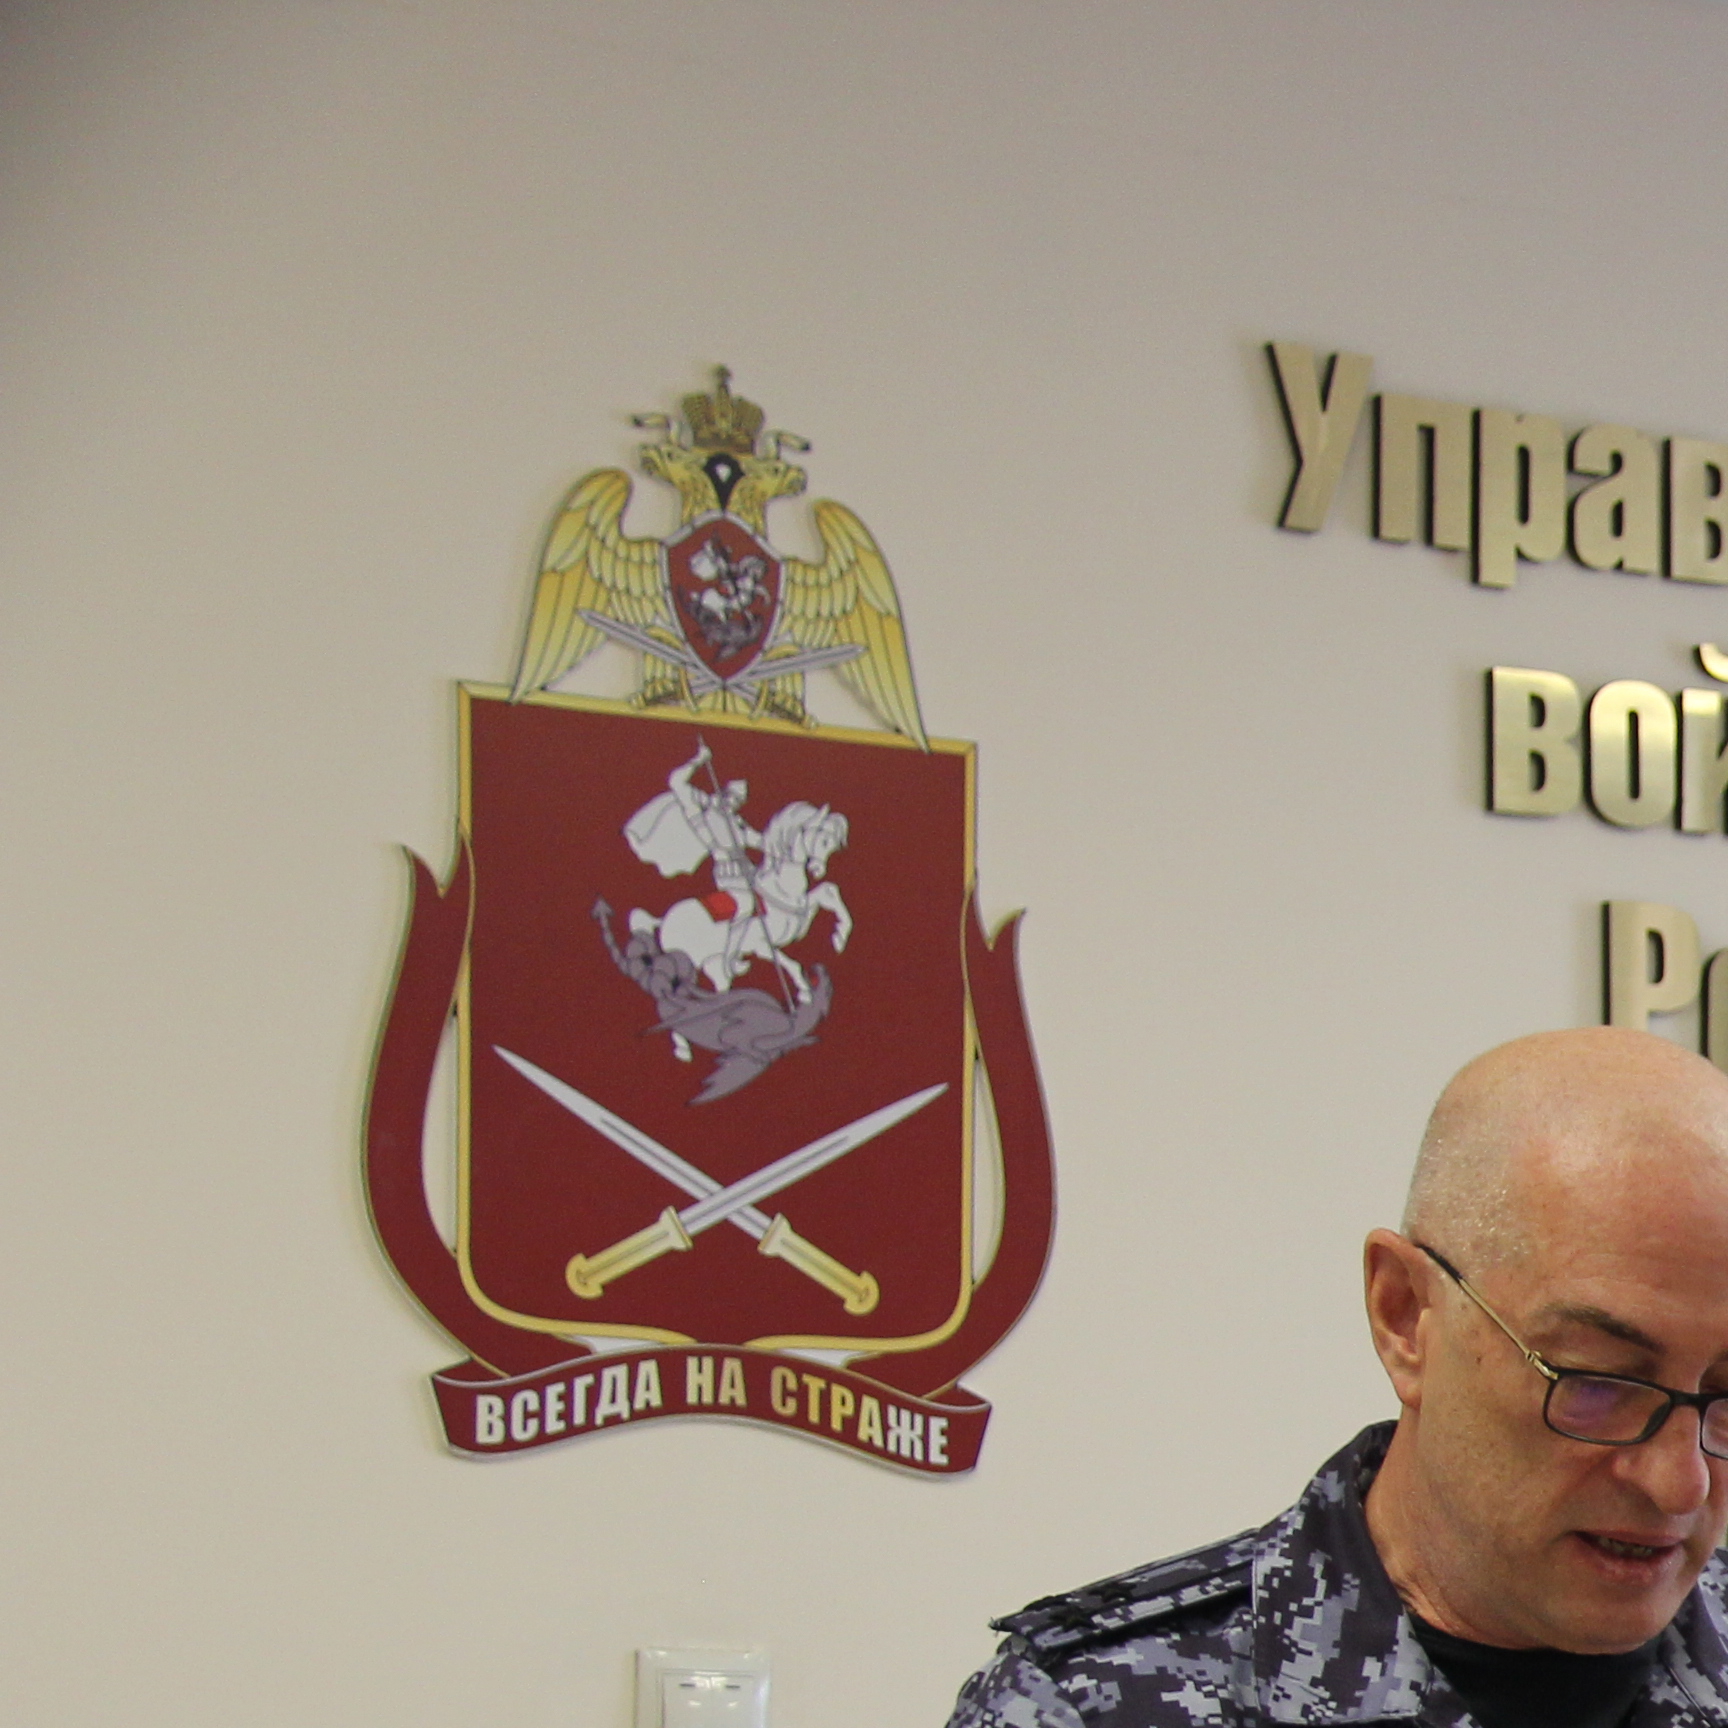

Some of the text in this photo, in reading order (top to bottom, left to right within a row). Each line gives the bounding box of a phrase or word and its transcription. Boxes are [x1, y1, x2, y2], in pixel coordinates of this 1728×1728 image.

[474, 1355, 950, 1467] ВСЕГДА НА СТРАЖЕ
